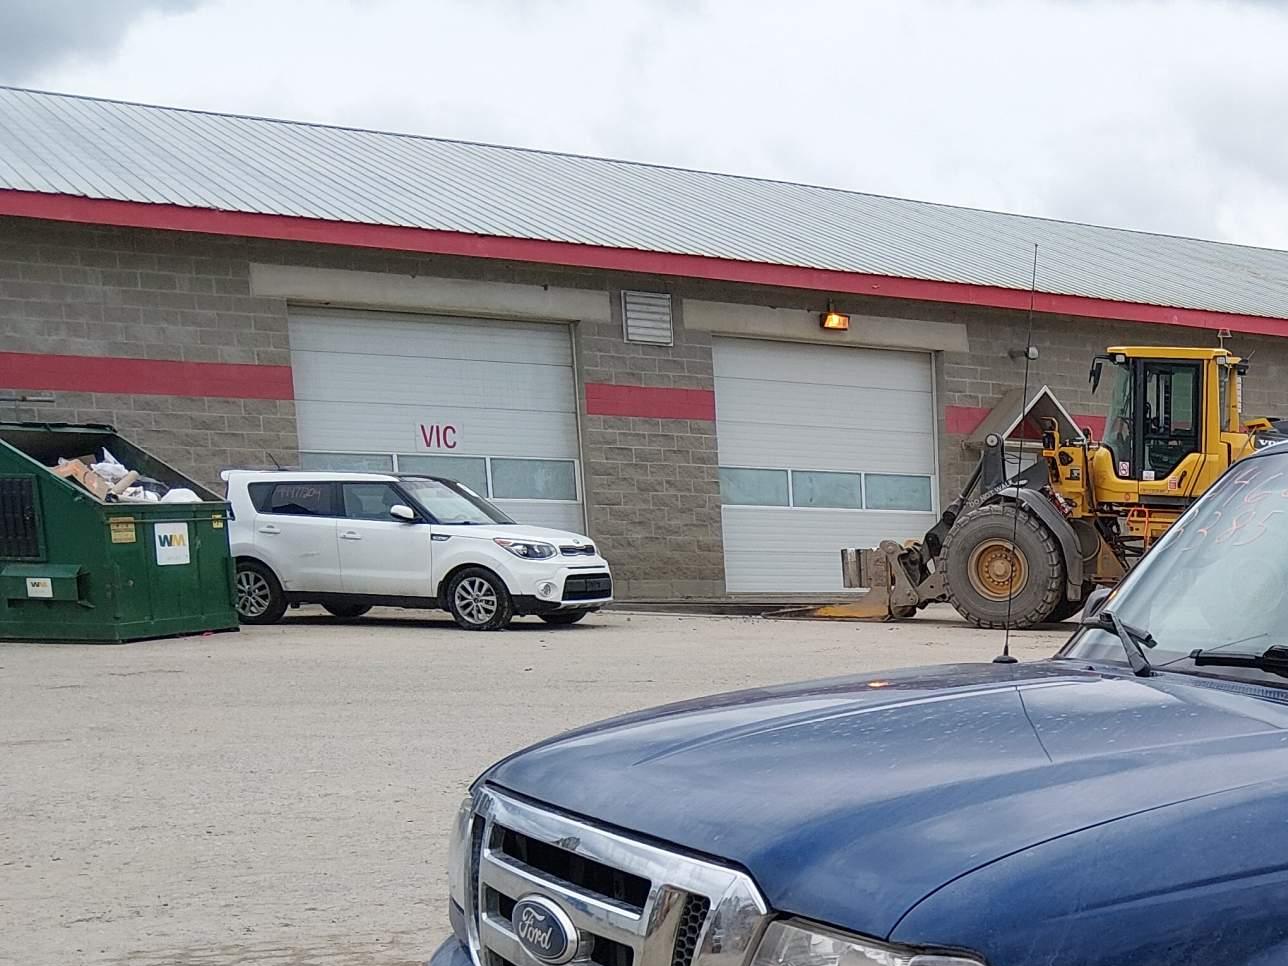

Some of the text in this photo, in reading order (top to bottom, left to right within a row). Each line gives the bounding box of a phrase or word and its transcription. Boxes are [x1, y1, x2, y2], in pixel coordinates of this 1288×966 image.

[420, 424, 457, 449] VIC
[158, 534, 186, 547] WM
[518, 906, 553, 950] Ford
